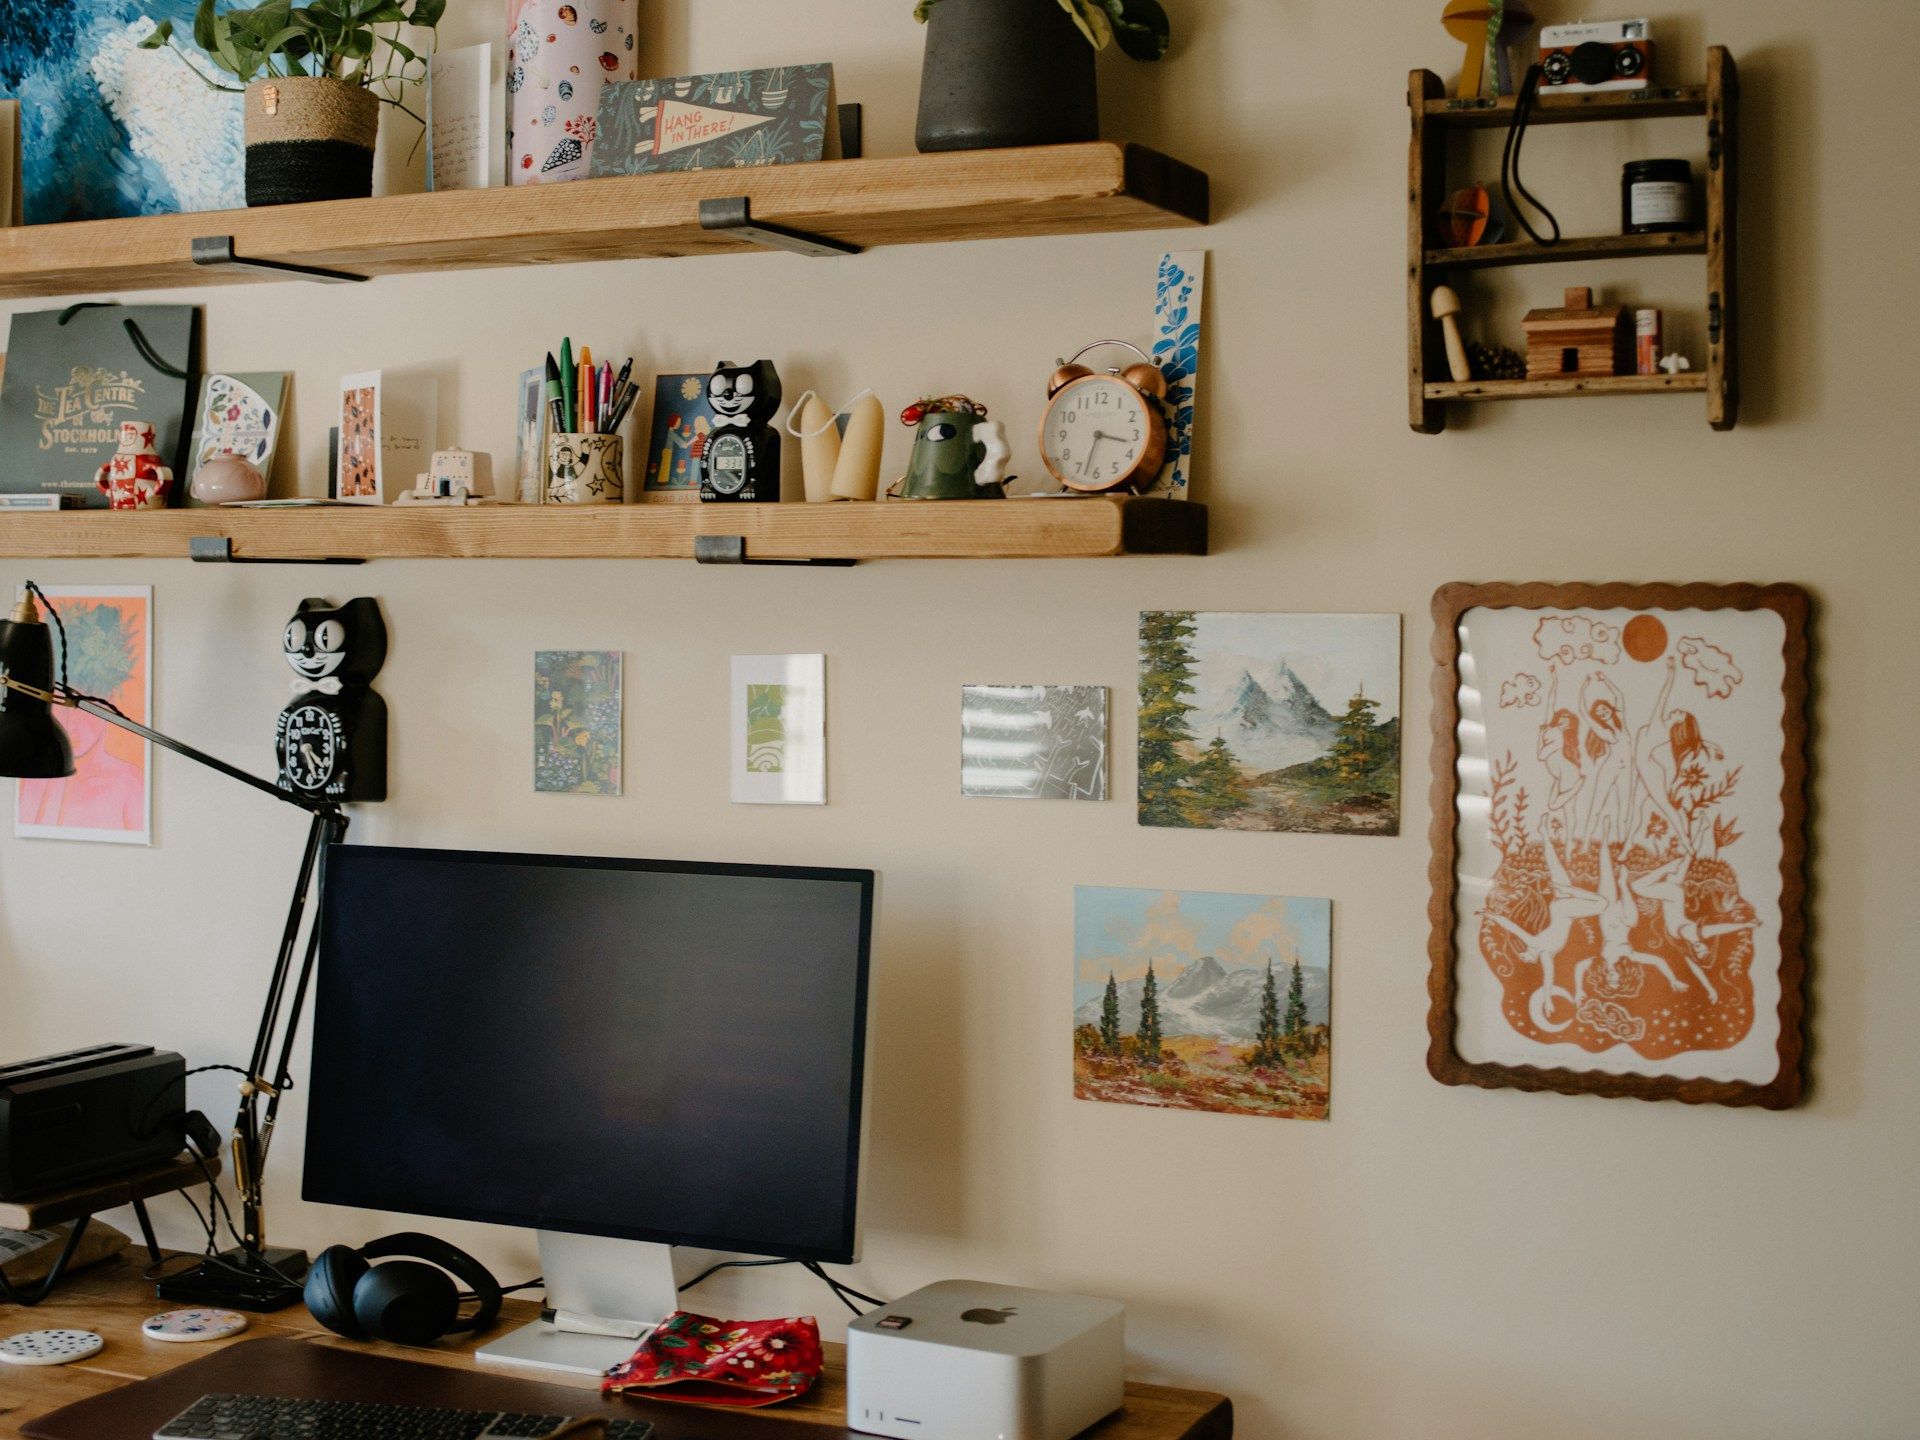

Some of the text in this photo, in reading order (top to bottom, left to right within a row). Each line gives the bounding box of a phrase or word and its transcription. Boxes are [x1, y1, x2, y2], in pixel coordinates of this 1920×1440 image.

[664, 111, 703, 134] HANG
[672, 114, 735, 143] IN THERE!
[38, 381, 136, 424] THE TEA CENTRE
[1078, 397, 1089, 410] 11
[1095, 392, 1108, 404] 12
[1118, 397, 1122, 410] 1
[1062, 411, 1076, 424] 10
[1128, 410, 1136, 423] 2
[1060, 430, 1067, 442] 9
[1132, 429, 1140, 442] 3
[1062, 448, 1070, 460] 8
[1125, 448, 1134, 460] 4
[1075, 462, 1083, 474] 7
[1092, 467, 1100, 480] 6
[1112, 462, 1119, 474] 5
[296, 716, 303, 727] 11
[304, 710, 315, 722] 12
[319, 716, 324, 727] 1
[322, 729, 329, 740] 2
[290, 743, 298, 754] 9
[322, 743, 330, 754] 3
[296, 768, 303, 779] 7
[306, 773, 314, 784] 6
[318, 768, 325, 779] 5
